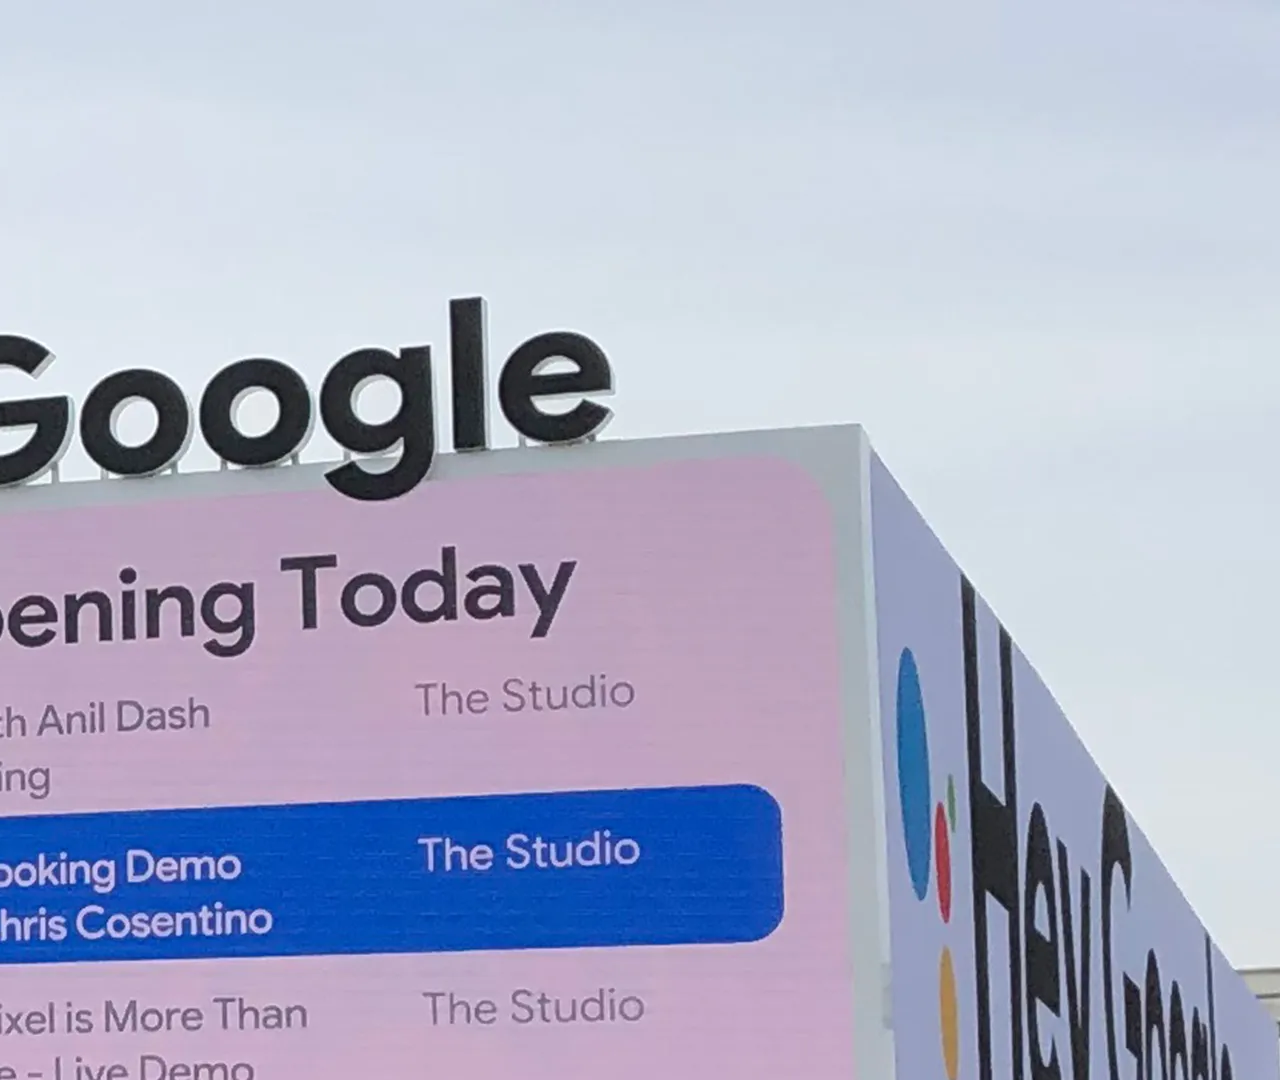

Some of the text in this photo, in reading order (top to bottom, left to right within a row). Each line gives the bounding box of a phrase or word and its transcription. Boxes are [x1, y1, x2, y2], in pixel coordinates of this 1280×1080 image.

[280, 547, 577, 638] Today
[414, 673, 635, 716] The Studio
[36, 701, 105, 737] Anil
[116, 697, 210, 732] Dash
[126, 849, 242, 883] Demo
[417, 829, 641, 872] The Studio
[75, 901, 273, 940] Cosentino
[66, 1001, 94, 1034] is
[104, 999, 204, 1033] More
[212, 997, 308, 1031] Than
[422, 986, 645, 1026] The Studio
